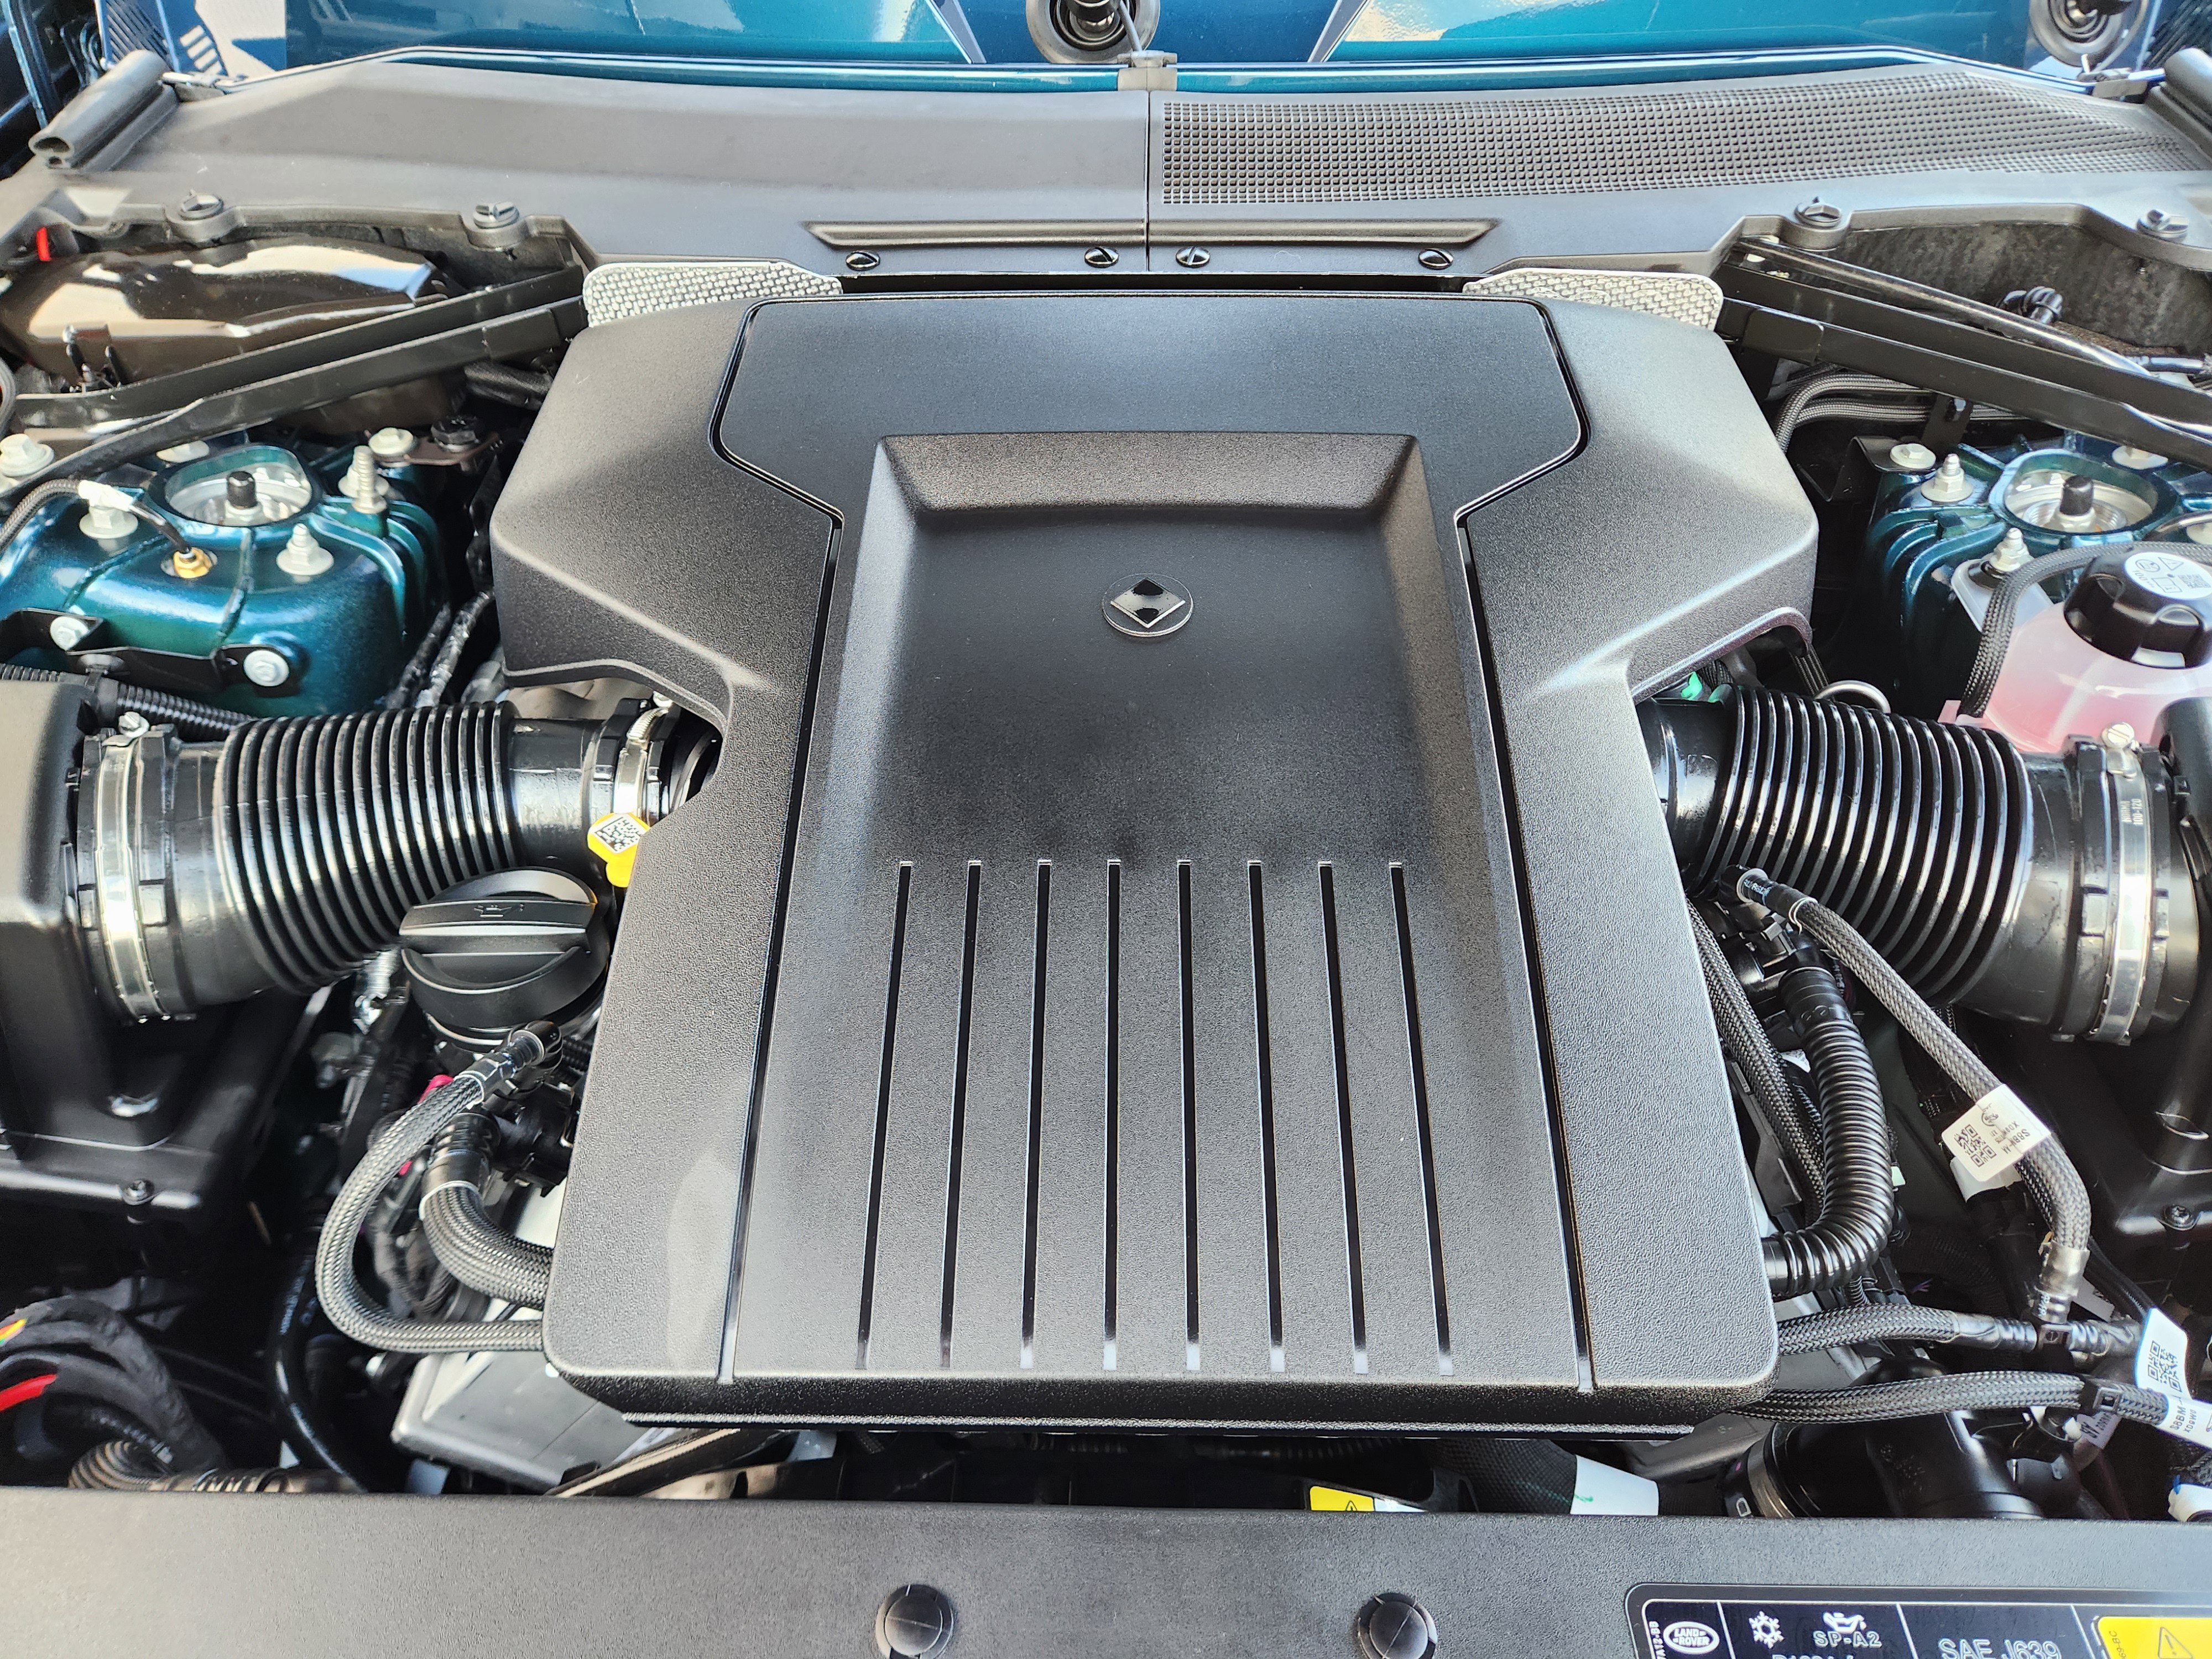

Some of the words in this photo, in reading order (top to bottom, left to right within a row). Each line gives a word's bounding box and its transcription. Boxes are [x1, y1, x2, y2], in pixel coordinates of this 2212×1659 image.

[1674, 1628, 1700, 1637] LAND
[1813, 1631, 1882, 1648] SP-A2
[1678, 1636, 1710, 1647] ROVER
[1938, 1638, 1996, 1659] SAE
[2001, 1639, 2062, 1659] J639
[2109, 1630, 2127, 1659] 69-BC
